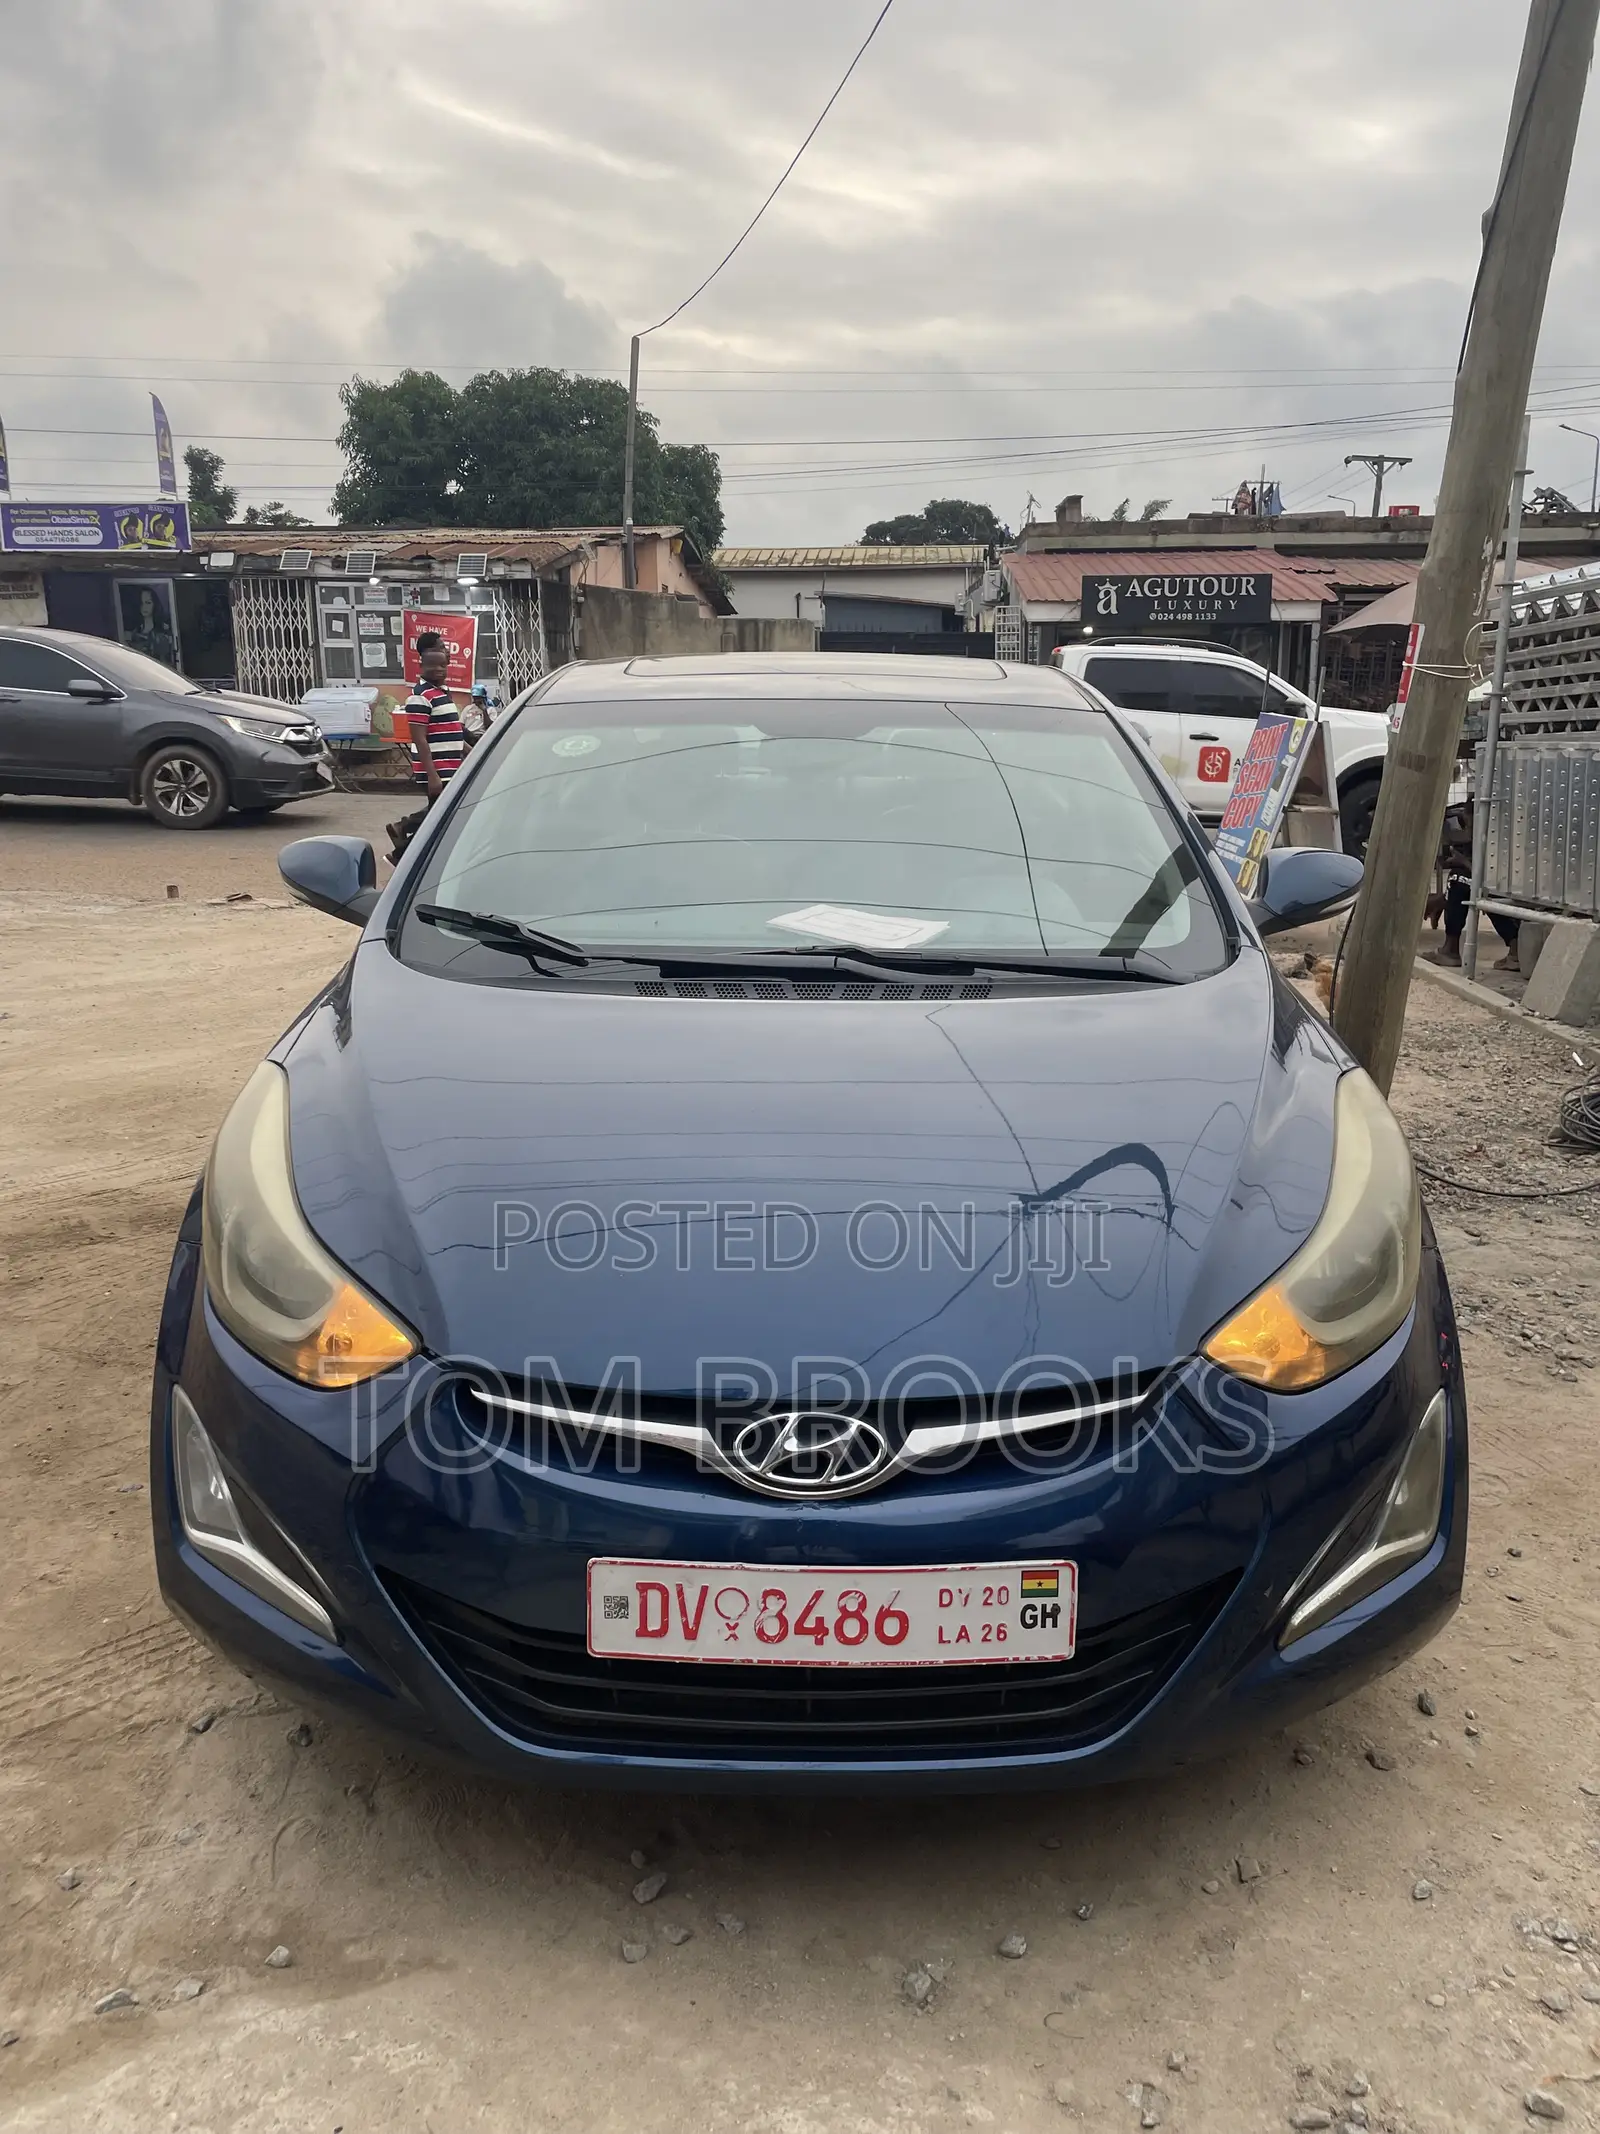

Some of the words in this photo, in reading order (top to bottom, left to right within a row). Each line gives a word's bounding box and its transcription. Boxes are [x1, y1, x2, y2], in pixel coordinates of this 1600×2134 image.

[1125, 576, 1257, 598] AGUTOUR
[1154, 600, 1238, 611] LUXURY
[1157, 612, 1174, 621] 024
[1176, 612, 1193, 621] 498
[1195, 612, 1217, 621] 1133
[415, 625, 428, 633] WE
[428, 626, 448, 635] HAVE
[1245, 722, 1290, 760] PRINT
[1233, 757, 1278, 795] SCAN
[1220, 794, 1265, 830] COPY
[982, 1585, 1010, 1607] 20
[635, 1581, 709, 1641] DV
[754, 1587, 910, 1647] 8486
[1020, 1603, 1062, 1630] GH
[938, 1623, 972, 1645] LA
[981, 1623, 1009, 1644] 26
